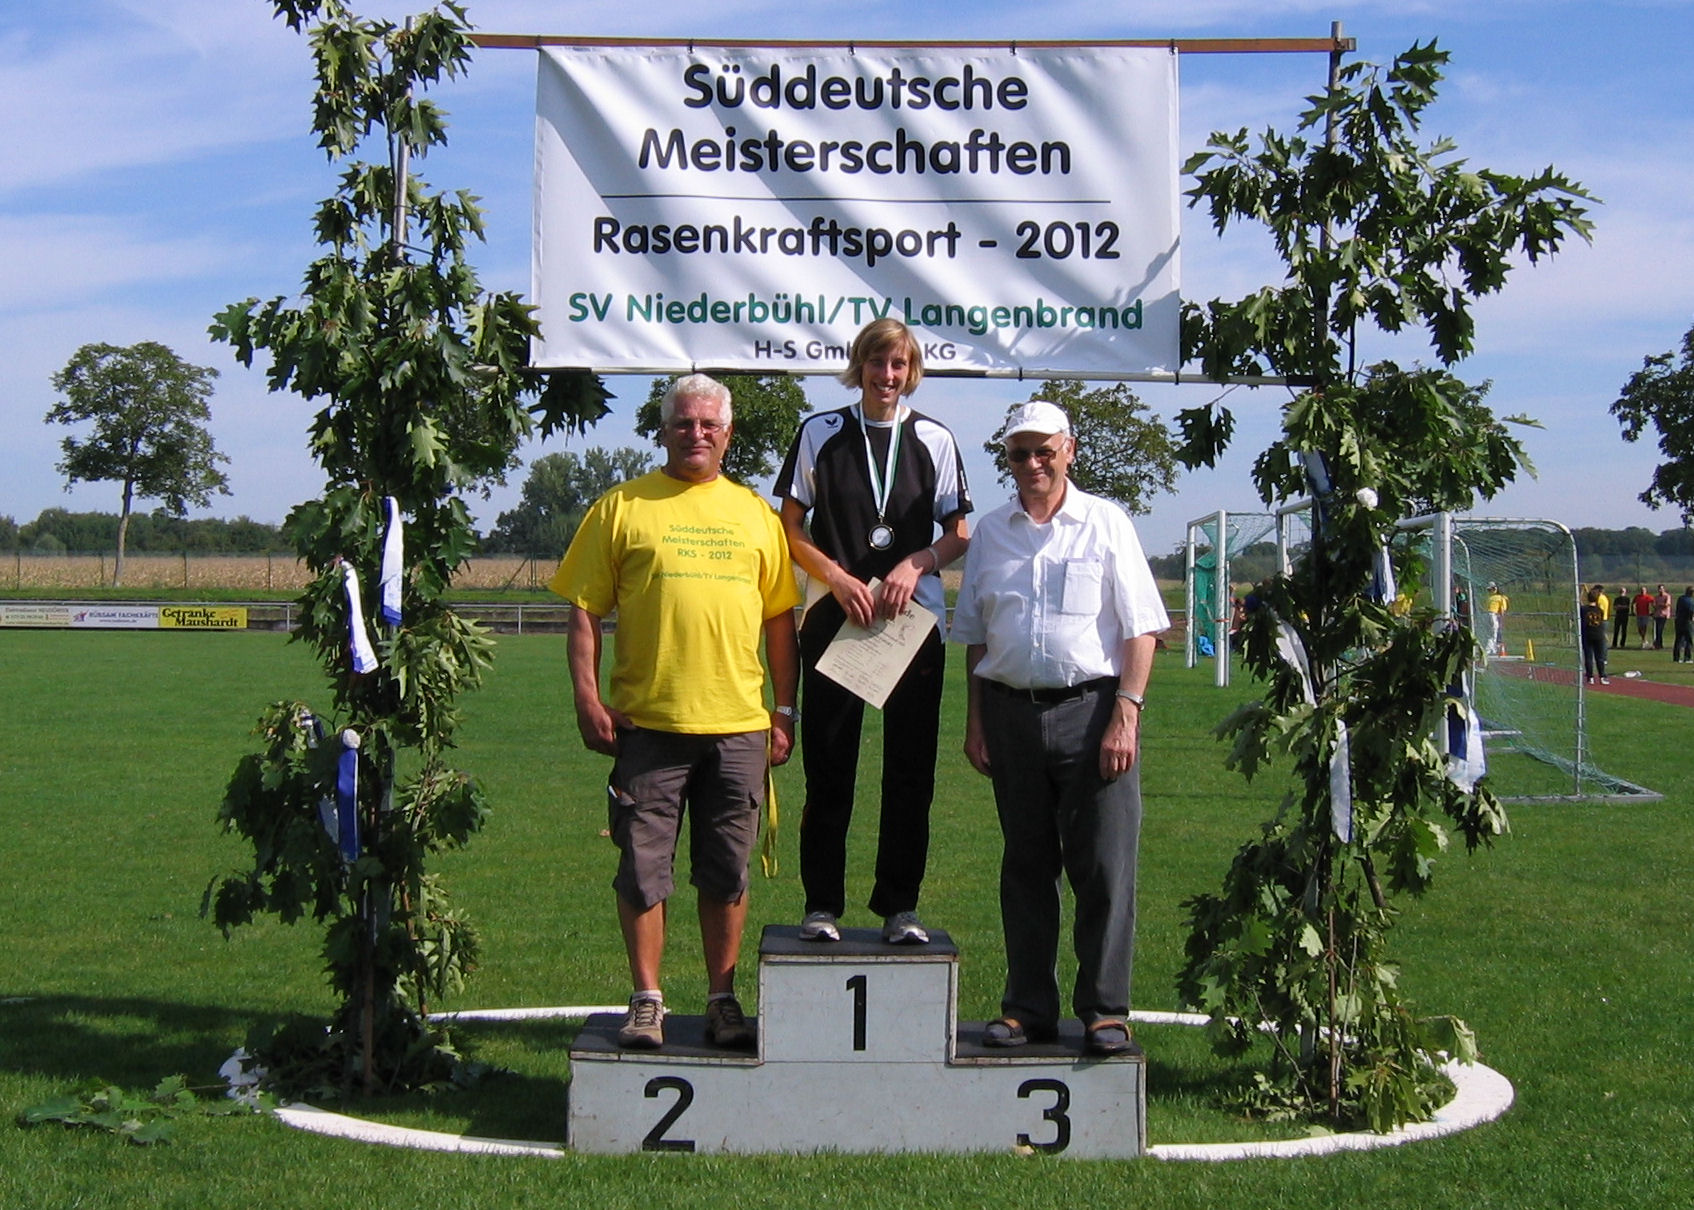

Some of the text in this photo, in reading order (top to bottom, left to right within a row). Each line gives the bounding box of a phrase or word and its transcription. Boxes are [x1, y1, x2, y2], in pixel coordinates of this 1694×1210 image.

[683, 63, 1029, 111] Süddeutsche
[638, 127, 1071, 175] Meisterschaften
[593, 215, 1121, 268] Rasenkraftsport - 2012
[568, 293, 613, 322] SV
[904, 297, 1144, 336] Langenbrand
[754, 339, 957, 361] H-S Gm KG
[662, 535, 745, 548] Meisterschaften
[669, 524, 734, 535] Süddeutsche
[677, 548, 697, 558] RKS
[708, 551, 733, 560] 2012
[845, 974, 868, 1052] 1
[641, 1075, 696, 1152] 2
[1016, 1078, 1071, 1155] 3
